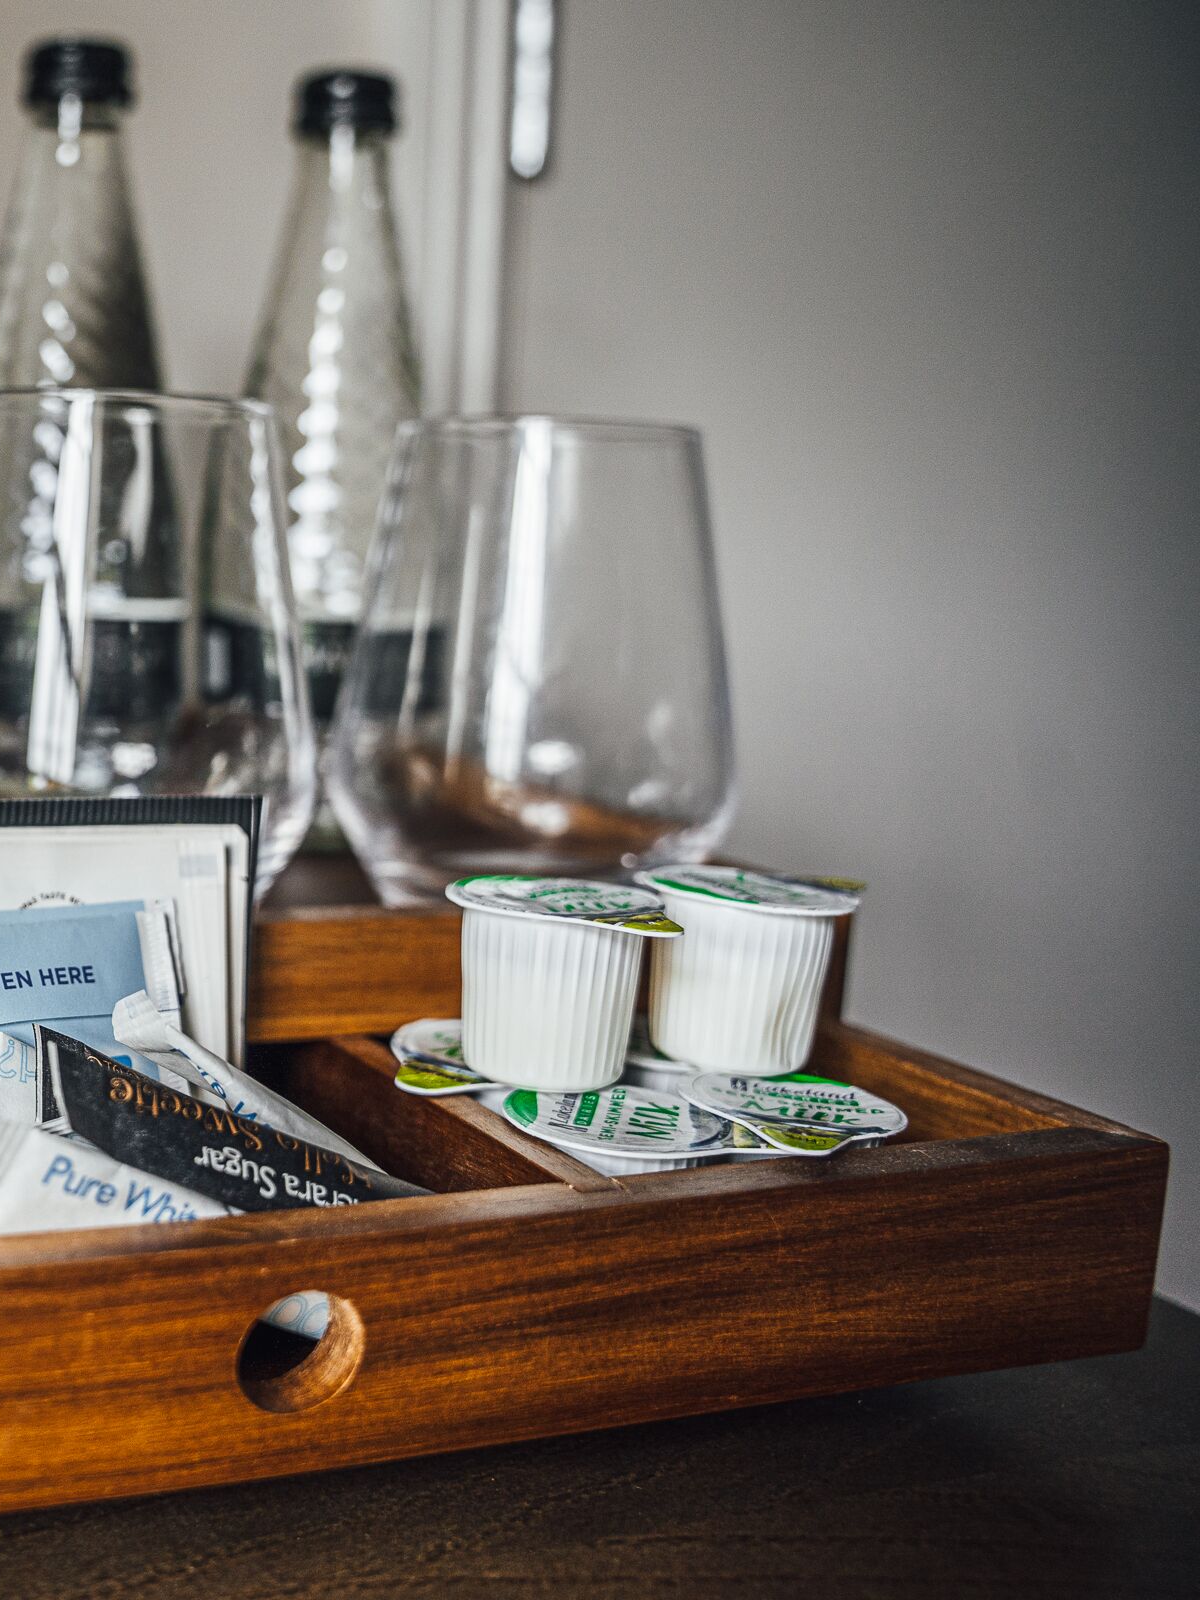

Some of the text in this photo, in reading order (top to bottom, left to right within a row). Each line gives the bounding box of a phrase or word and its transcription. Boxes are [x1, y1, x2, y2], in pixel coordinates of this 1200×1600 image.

[39, 964, 96, 987] HERE
[42, 1153, 118, 1206] Pure
[194, 1145, 277, 1198] Sugar
